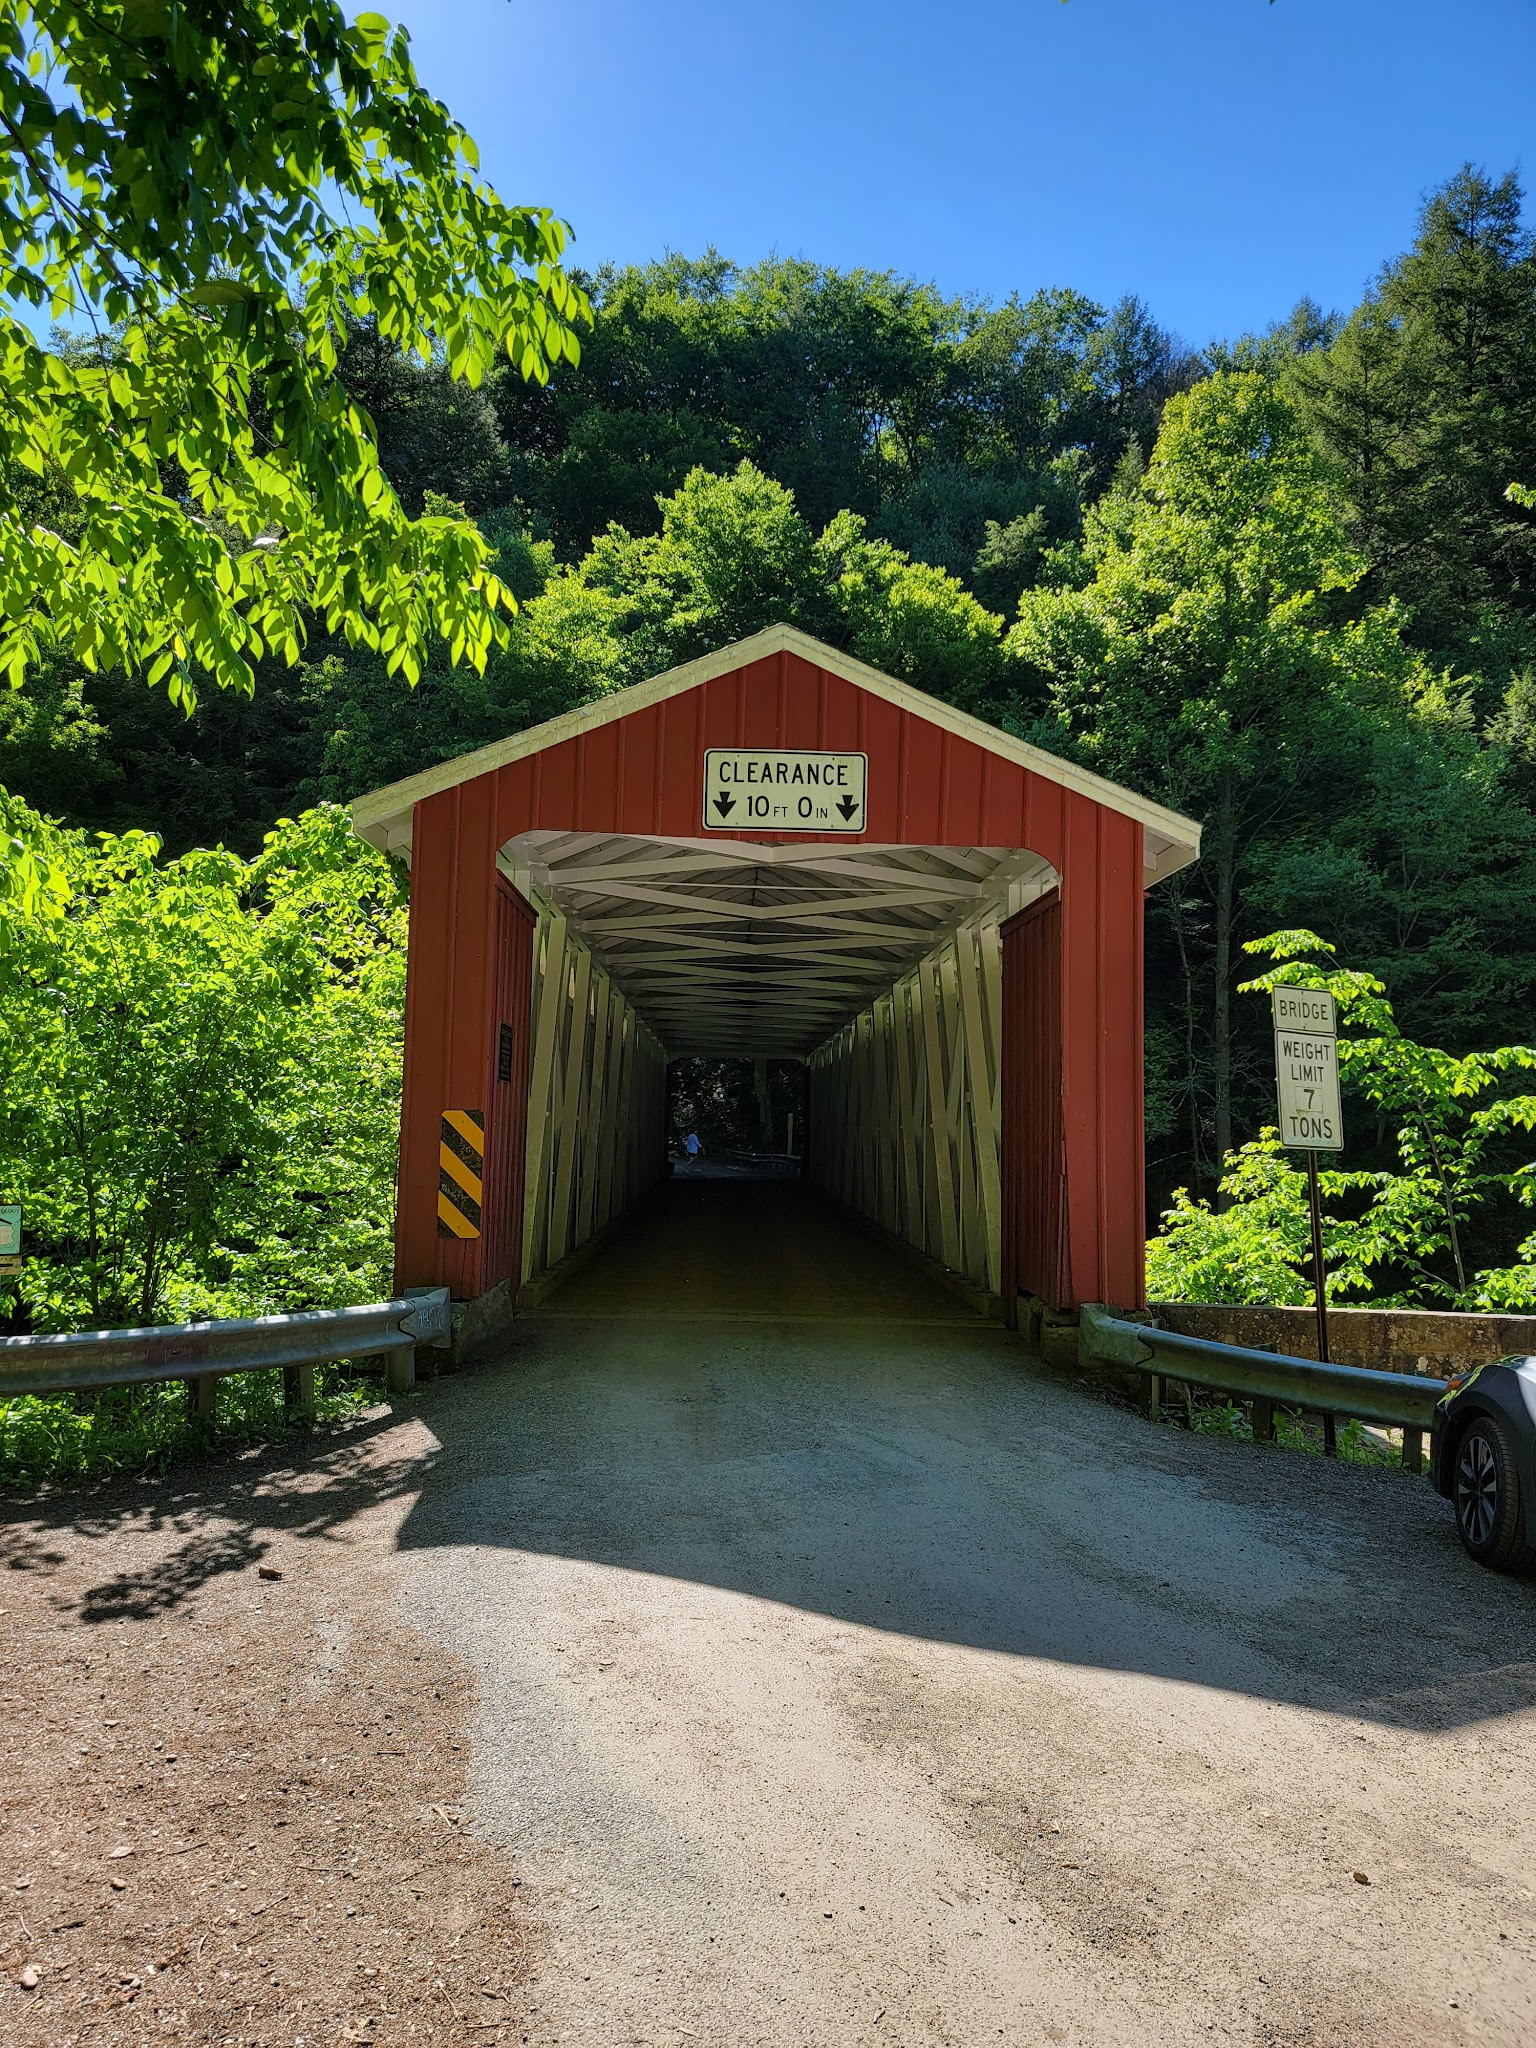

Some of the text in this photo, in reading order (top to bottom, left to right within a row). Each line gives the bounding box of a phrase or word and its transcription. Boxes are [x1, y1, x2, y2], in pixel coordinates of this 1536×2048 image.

[719, 761, 848, 786] CLEARANCE
[747, 795, 828, 818] 10 FT 0 IN
[1280, 1000, 1329, 1020] BRIDGE
[1282, 1040, 1331, 1061] WEIGHT
[1290, 1064, 1324, 1083] LIMIT
[1303, 1088, 1315, 1110] 7
[1289, 1116, 1333, 1139] TONS
